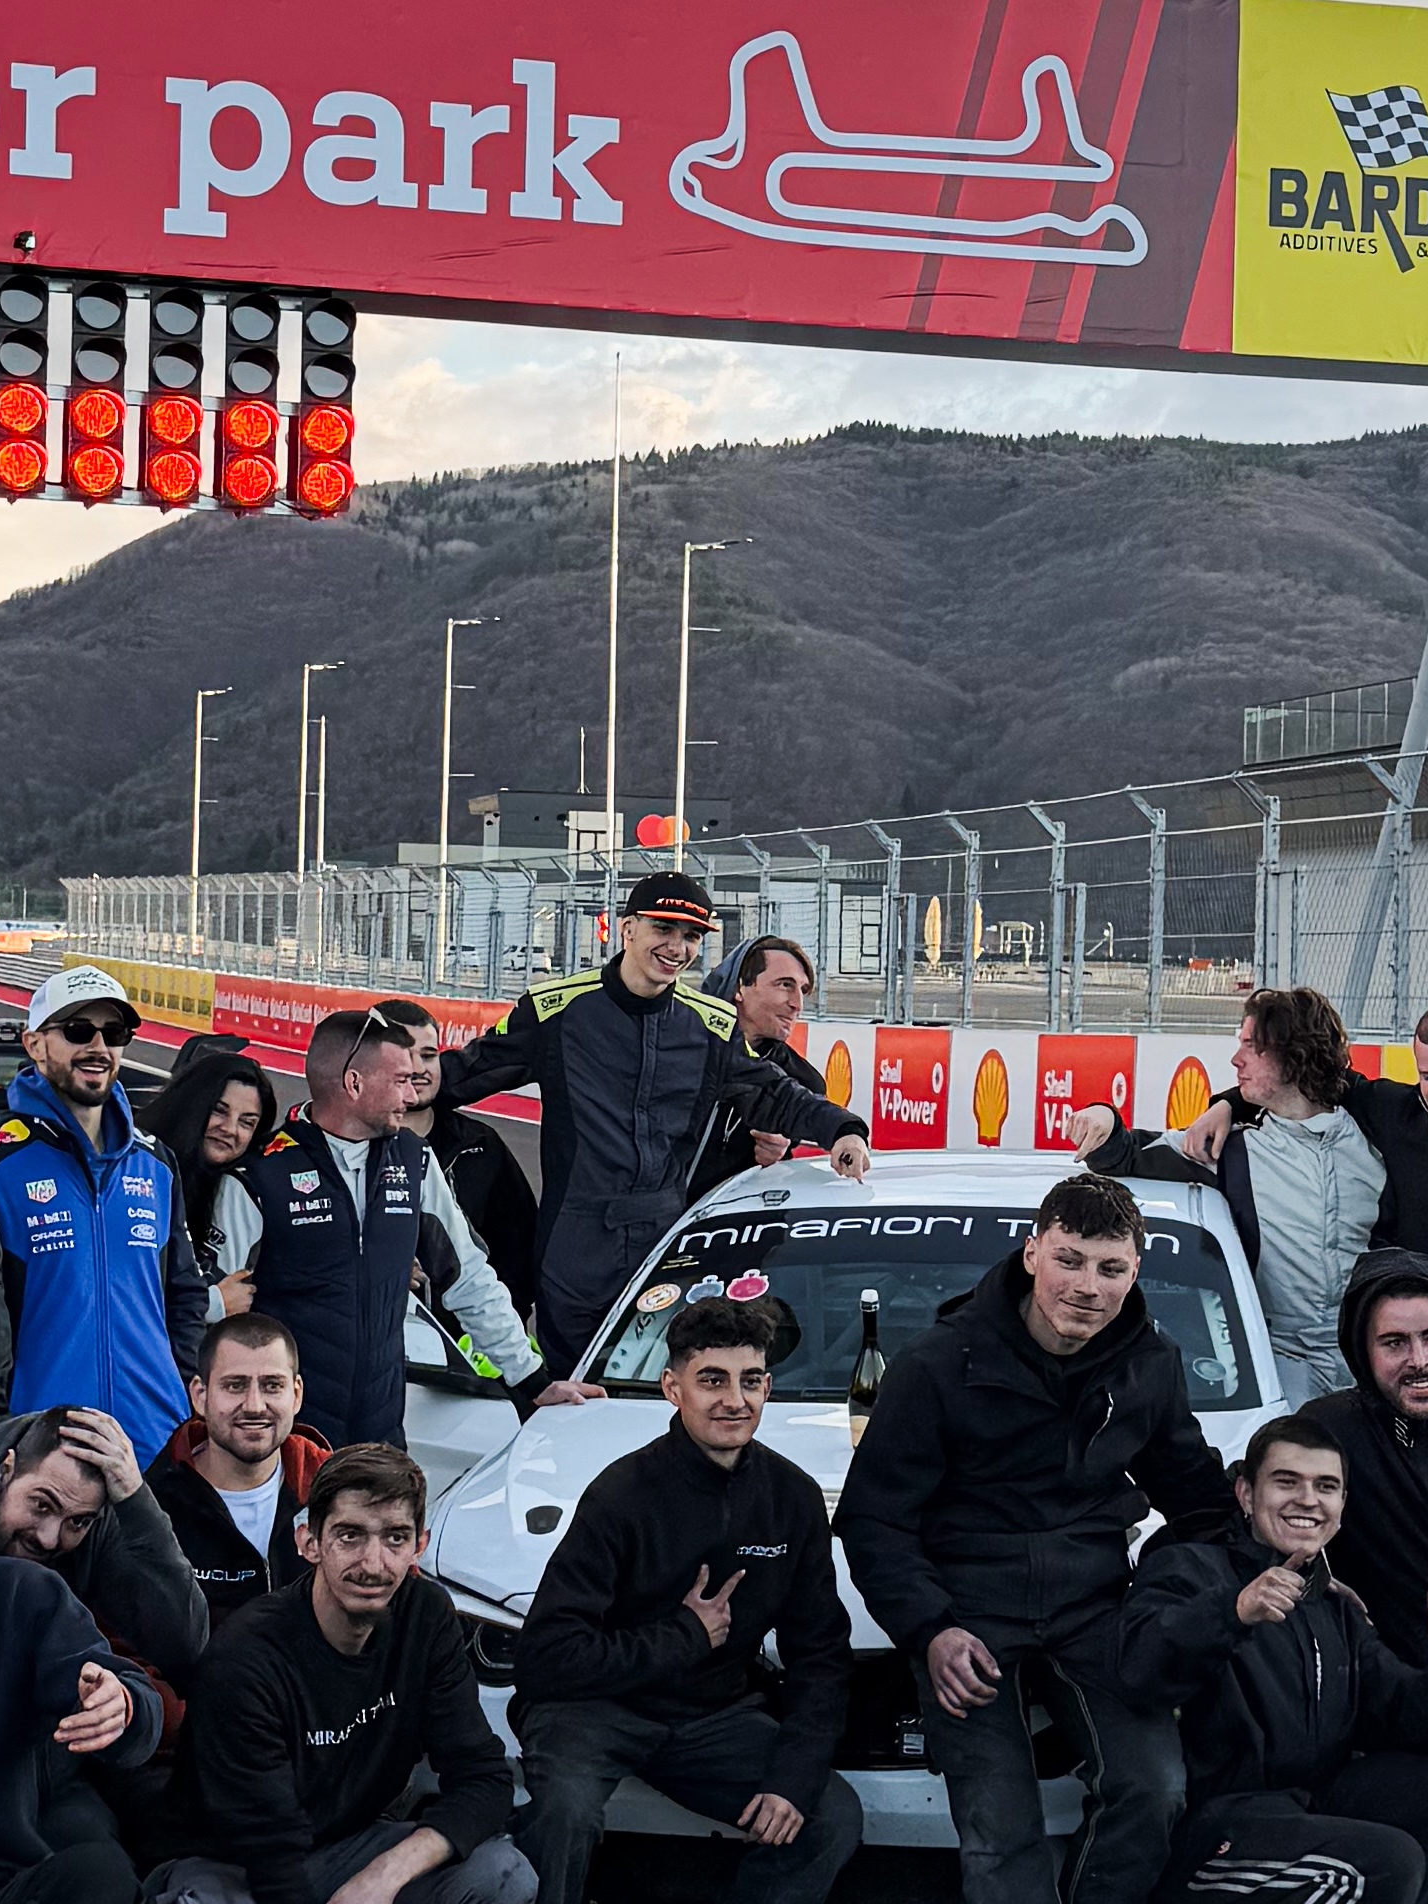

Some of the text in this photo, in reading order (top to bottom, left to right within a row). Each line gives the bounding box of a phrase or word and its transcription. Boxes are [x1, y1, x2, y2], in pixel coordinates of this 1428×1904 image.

[163, 58, 624, 239] park
[1279, 232, 1378, 256] ADDITIVES
[1415, 241, 1428, 259] &
[879, 1058, 903, 1083] Shell
[1044, 1069, 1073, 1098] Shell
[879, 1087, 938, 1126] V-Power
